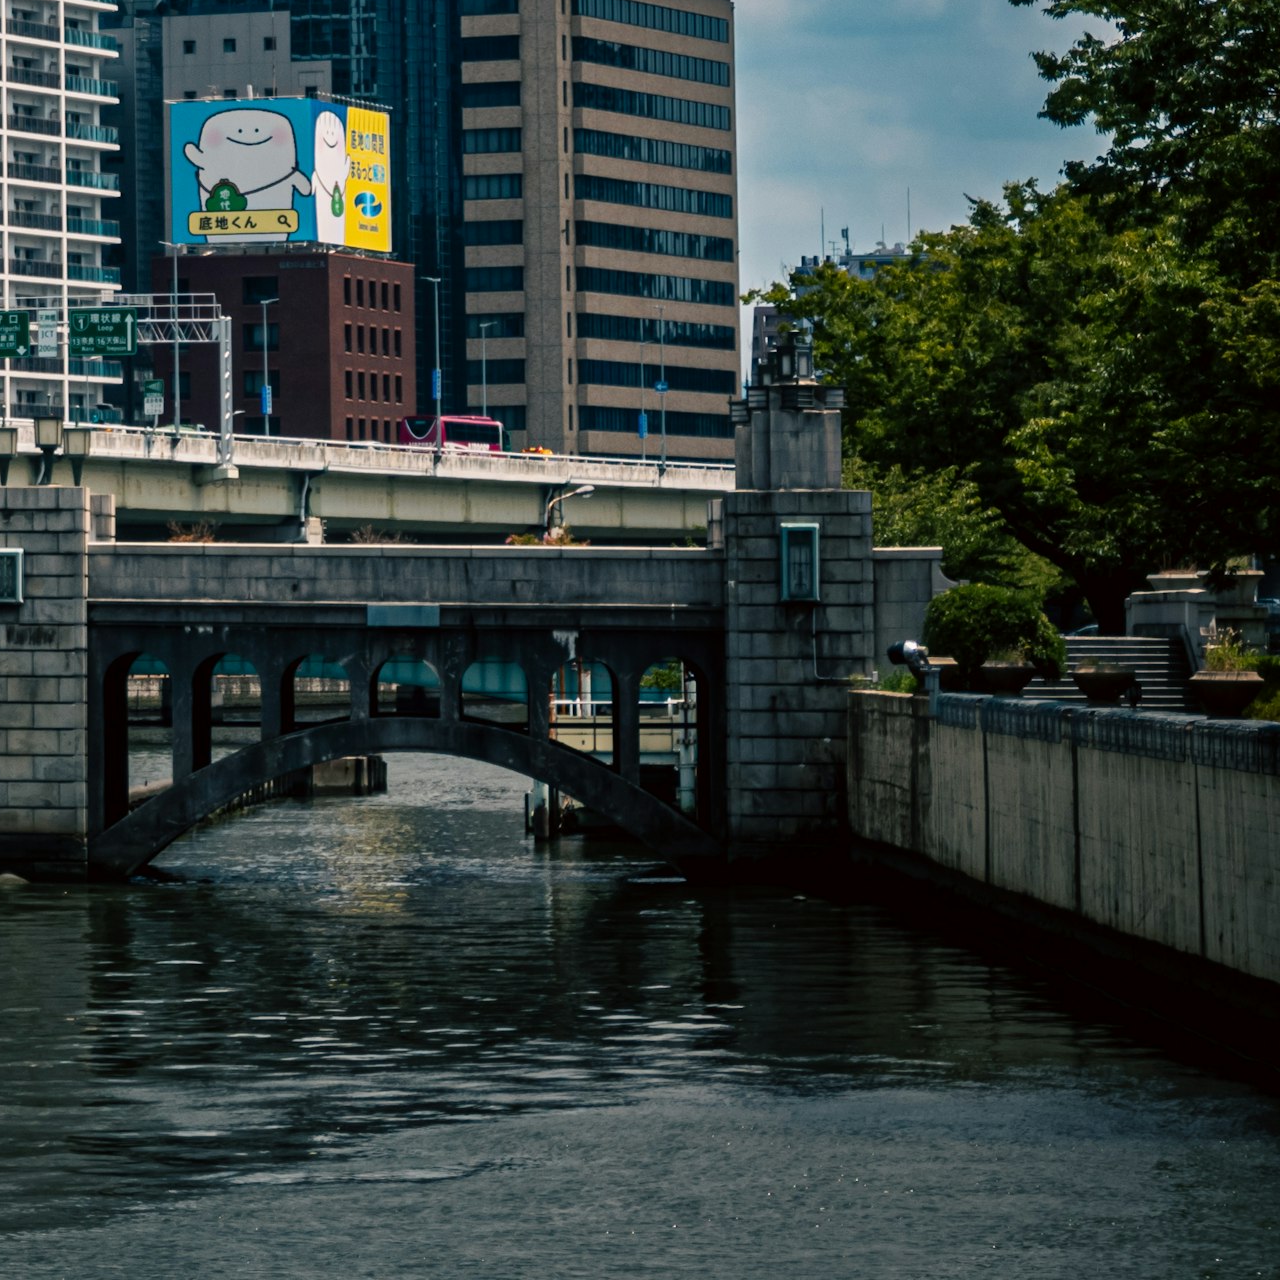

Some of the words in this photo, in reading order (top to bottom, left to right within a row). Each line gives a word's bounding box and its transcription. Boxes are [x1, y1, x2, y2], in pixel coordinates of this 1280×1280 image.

[199, 216, 257, 231] 底地くん
[78, 318, 84, 330] 1
[90, 313, 121, 324] 環状線
[41, 330, 54, 338] JCT
